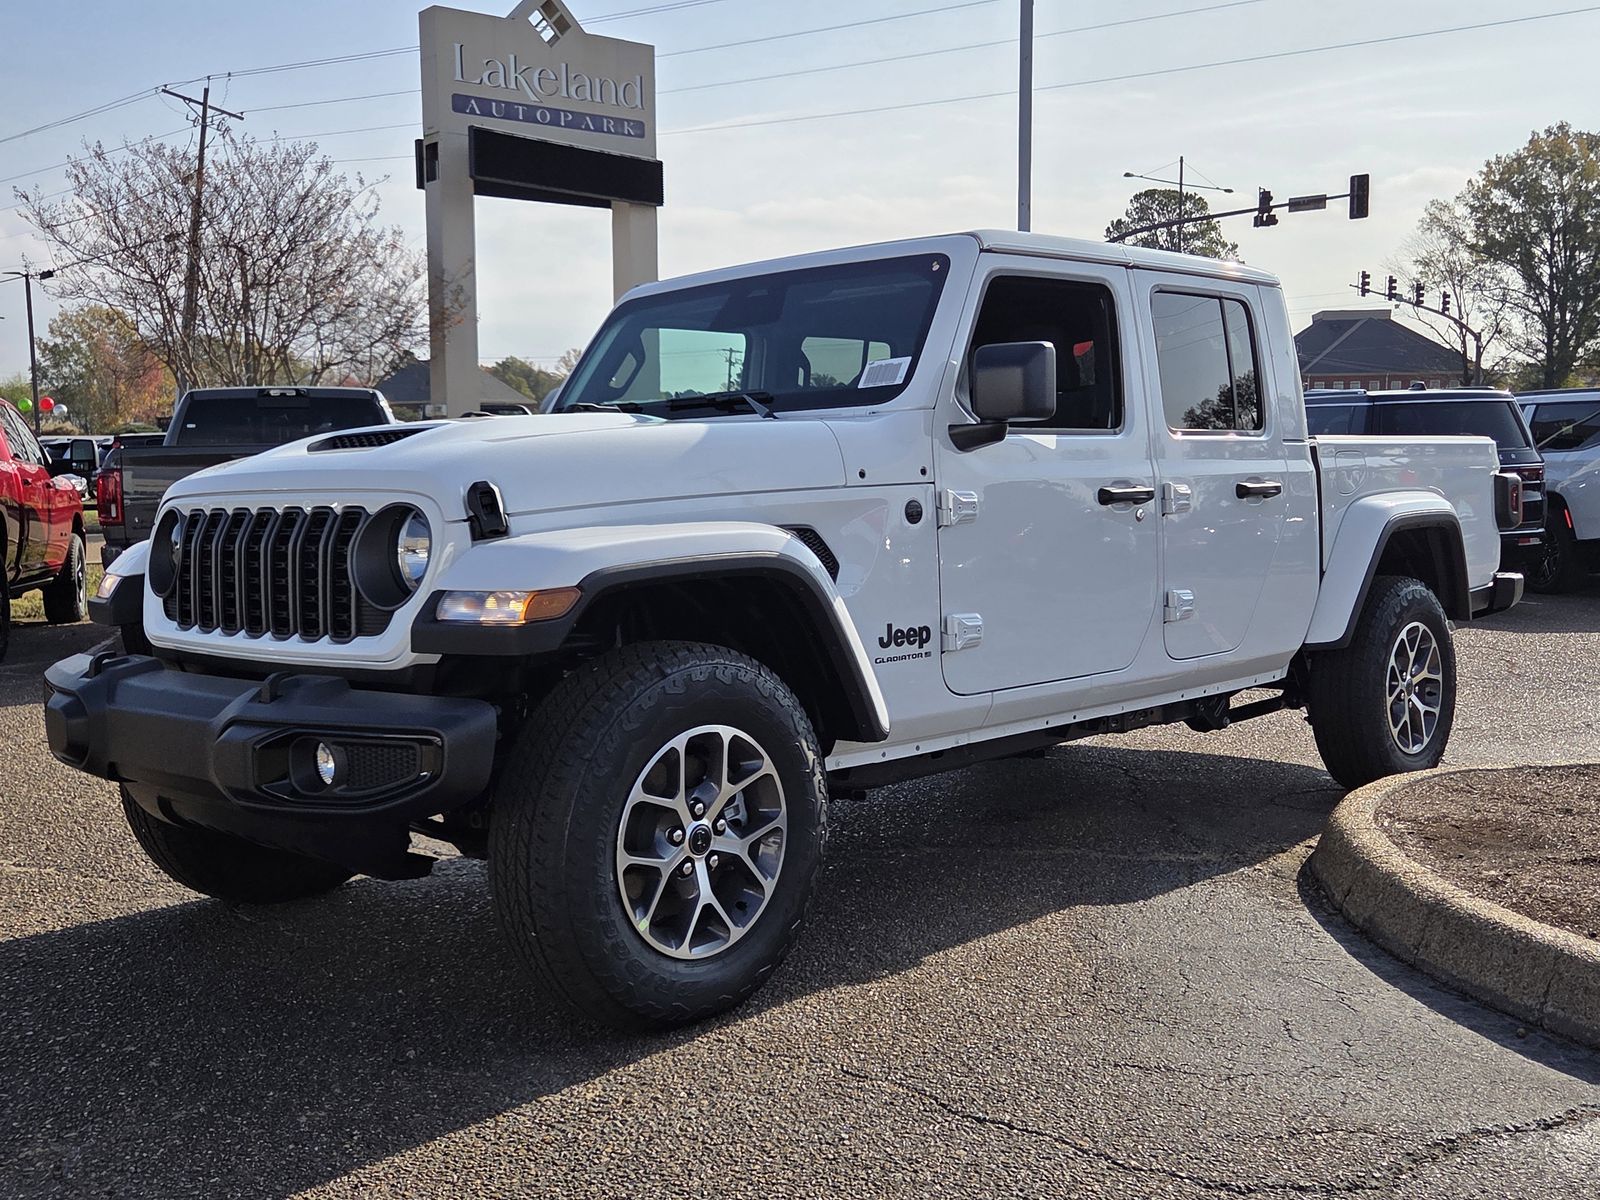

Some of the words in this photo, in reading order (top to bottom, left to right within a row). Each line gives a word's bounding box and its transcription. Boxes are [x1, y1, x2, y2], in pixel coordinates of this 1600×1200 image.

[452, 43, 645, 110] Lakeland
[466, 99, 635, 136] AUTOPARK
[878, 623, 931, 649] Jeep
[874, 652, 923, 664] GLADIATOR
